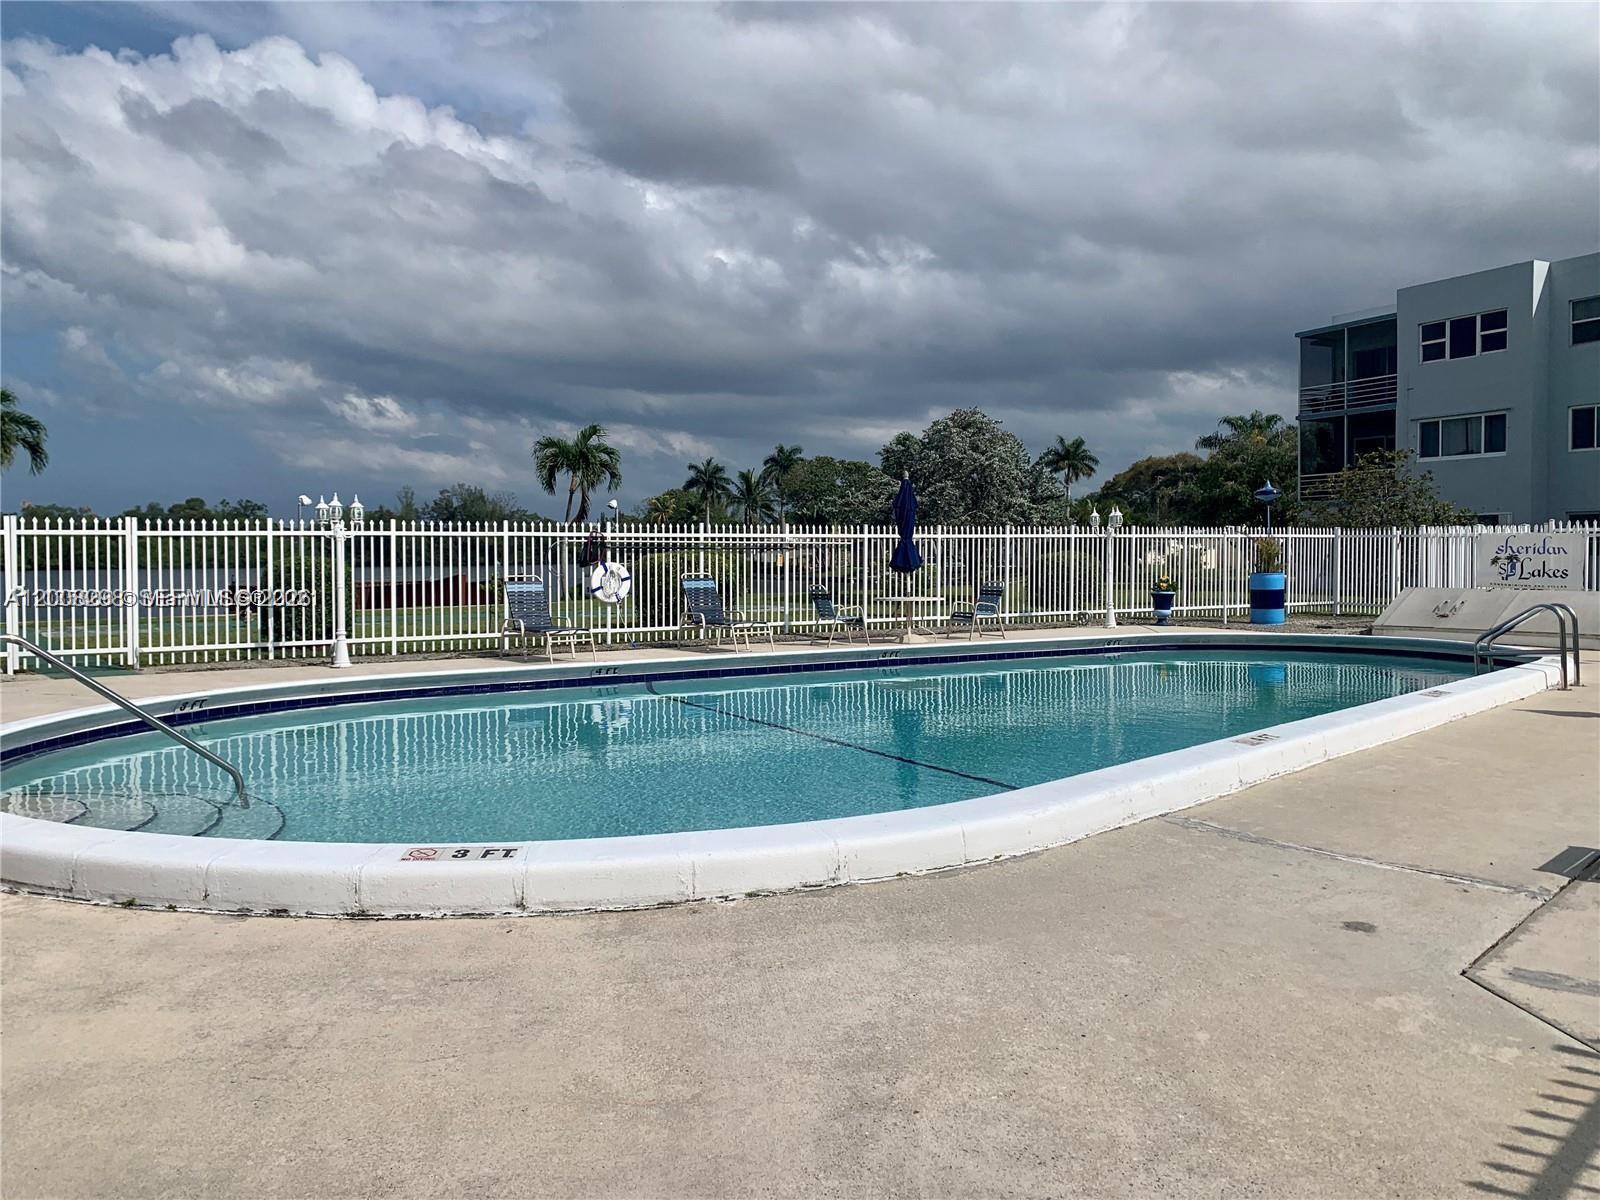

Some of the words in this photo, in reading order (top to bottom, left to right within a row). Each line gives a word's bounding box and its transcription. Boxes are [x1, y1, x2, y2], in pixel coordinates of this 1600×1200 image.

[1495, 534, 1569, 555] sheridan
[1518, 556, 1569, 580] Lakes
[451, 849, 471, 859] 3
